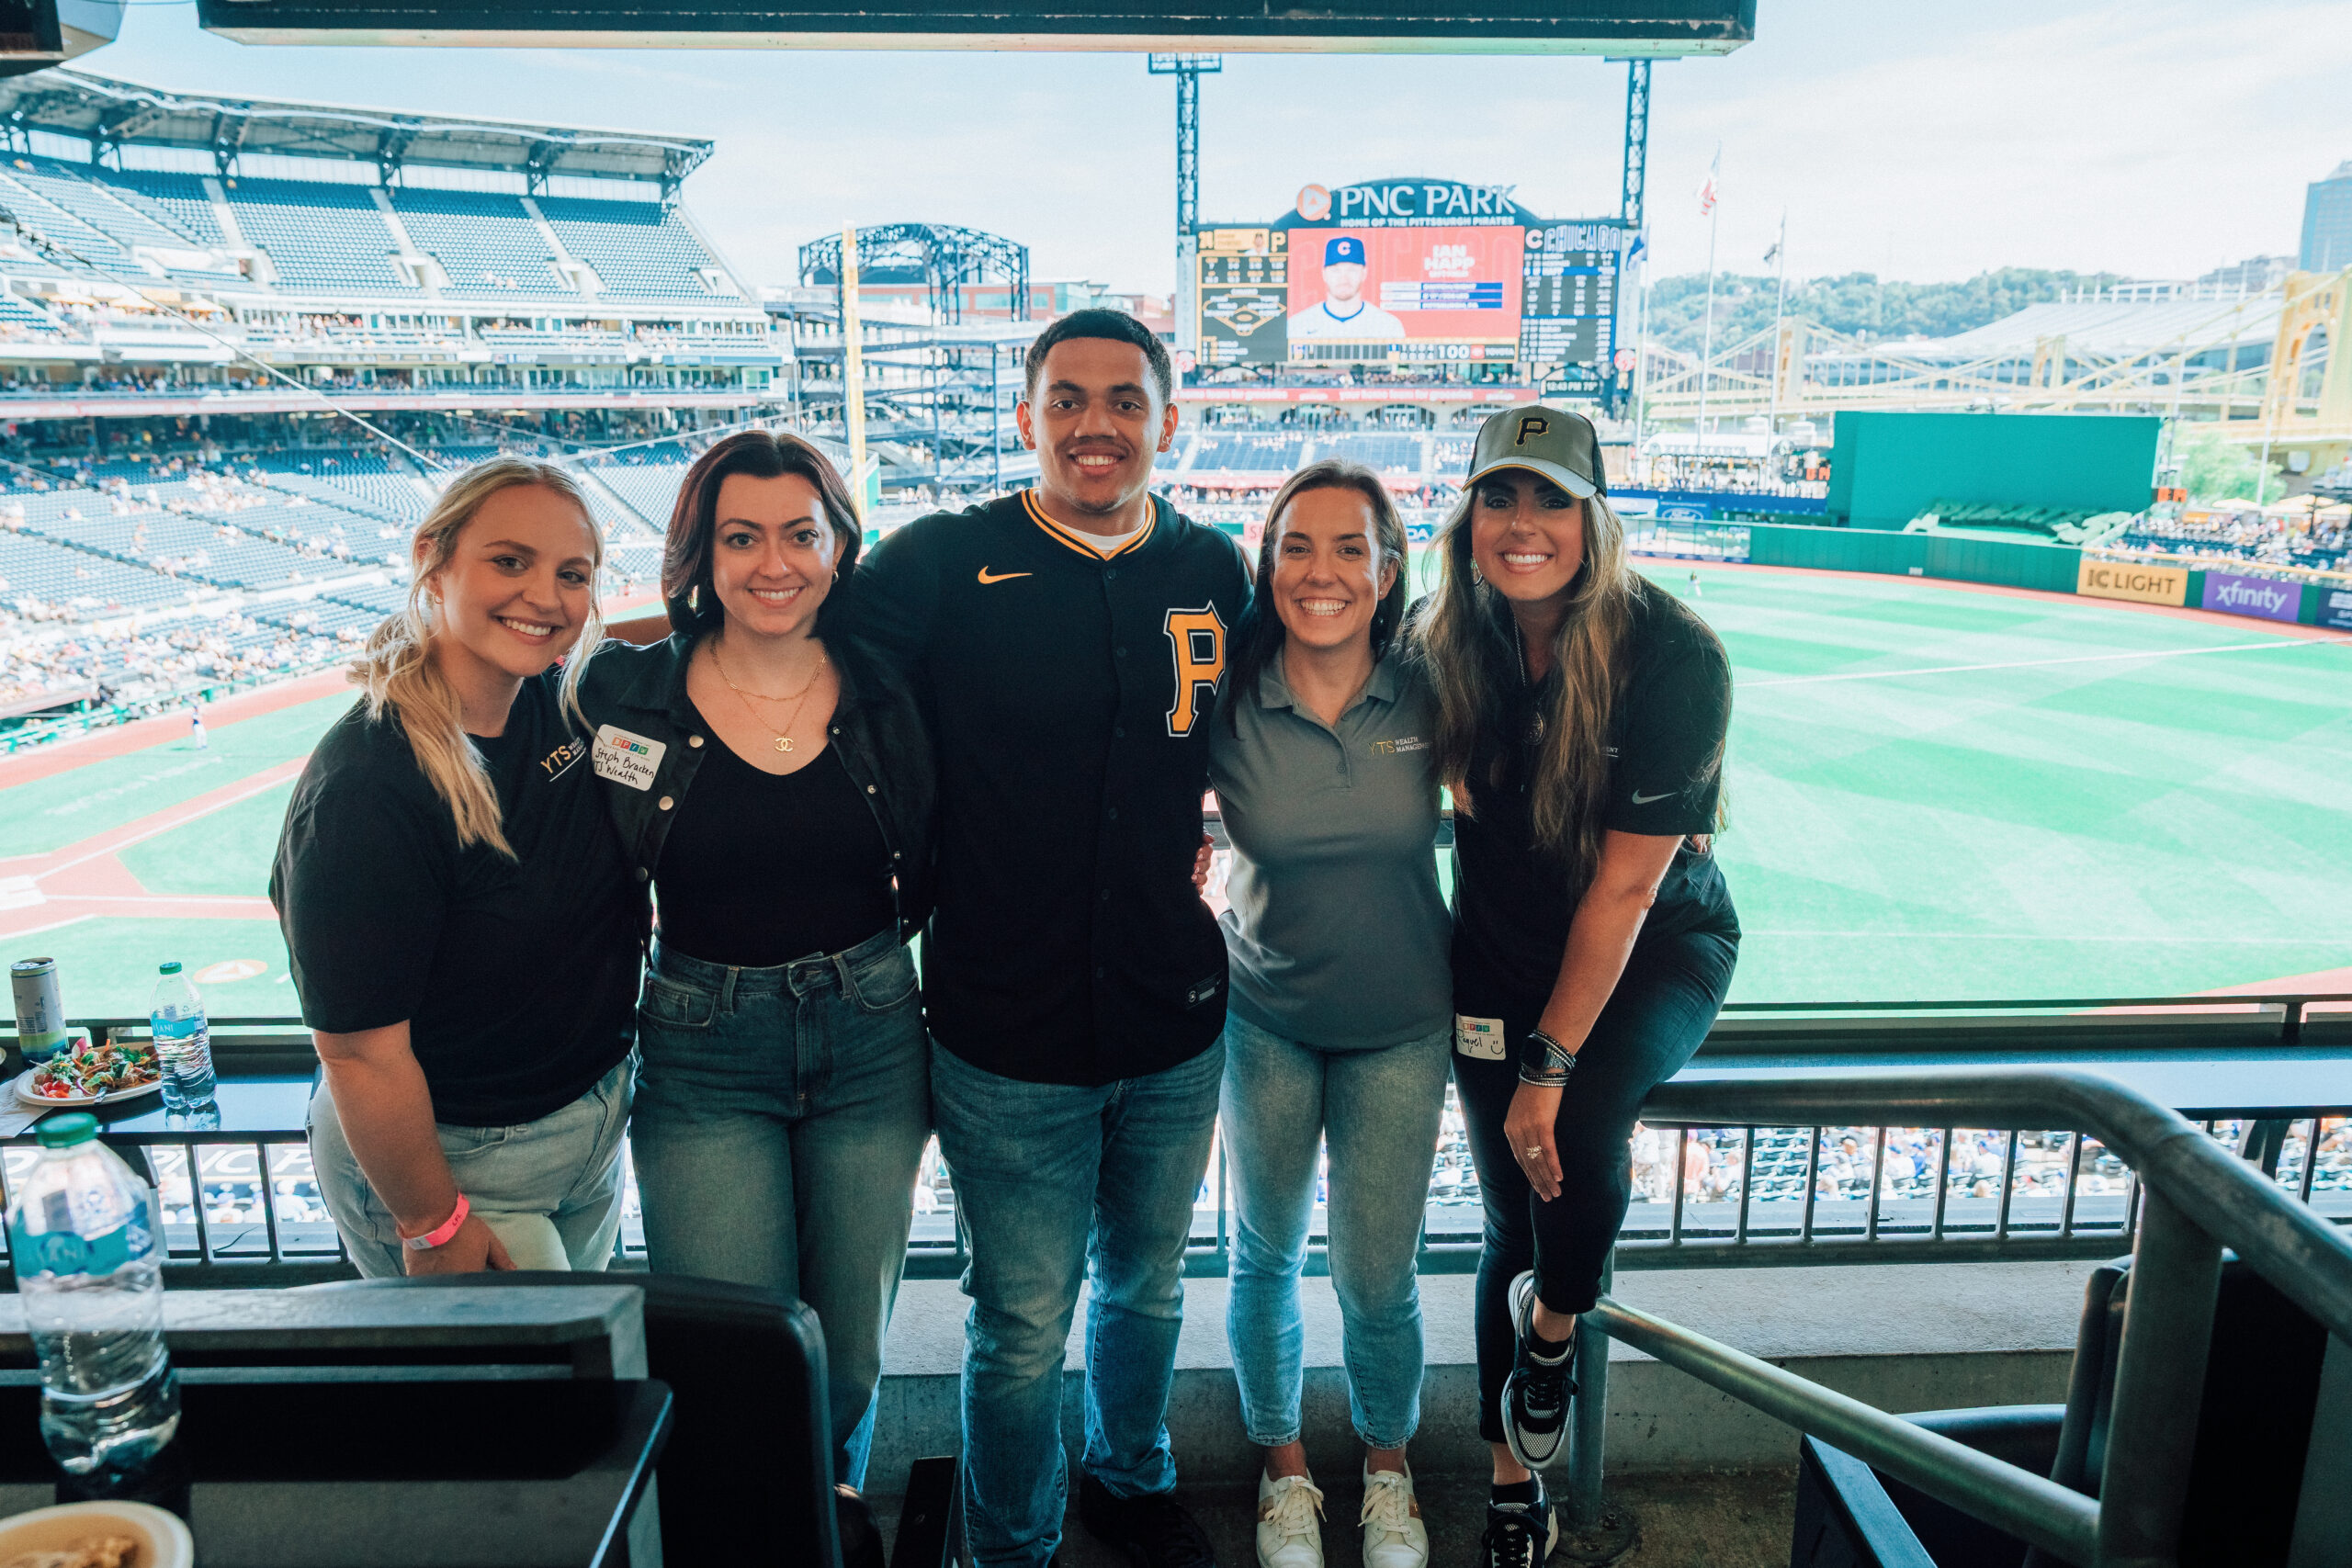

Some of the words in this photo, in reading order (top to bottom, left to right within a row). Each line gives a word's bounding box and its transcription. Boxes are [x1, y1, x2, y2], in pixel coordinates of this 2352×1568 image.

[1337, 186, 1415, 216] PNC
[1423, 184, 1518, 216] PARK
[1371, 218, 1386, 227] OF
[1388, 218, 1408, 227] THE
[1408, 217, 1471, 227] PITTSBURGH
[1473, 216, 1515, 226] PIRATES
[1433, 244, 1467, 257] IAN
[1424, 256, 1476, 271] HAPP
[1438, 344, 1470, 359] 100
[1514, 417, 1550, 446] P
[2086, 569, 2109, 589] IC
[2113, 571, 2177, 595] LIGHT
[2215, 580, 2289, 614] xfinity
[1163, 599, 1228, 738] P
[1368, 739, 1396, 755] YTS
[1395, 736, 1419, 746] WEALTH
[540, 745, 571, 773] YTS
[595, 748, 619, 764] Steph
[623, 756, 654, 779] Bracken
[606, 764, 639, 784] Wealth
